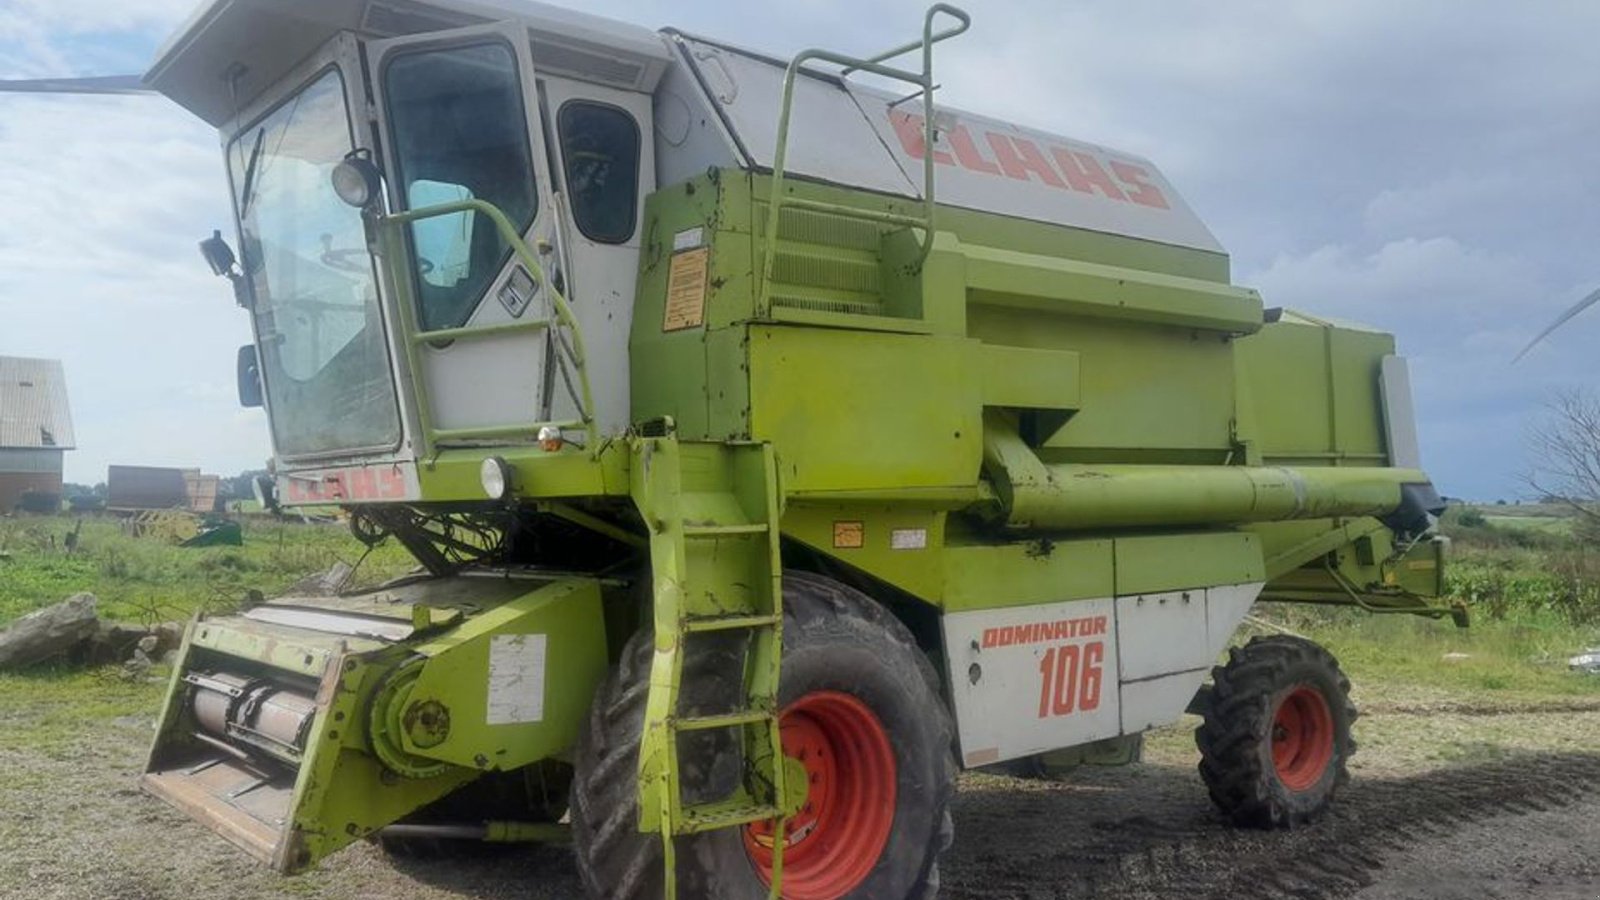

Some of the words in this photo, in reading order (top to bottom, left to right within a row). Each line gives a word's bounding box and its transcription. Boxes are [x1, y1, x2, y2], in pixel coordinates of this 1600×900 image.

[886, 109, 1170, 209] CLAAS
[982, 616, 1107, 648] DOMINATOR
[1038, 642, 1104, 718] 106
